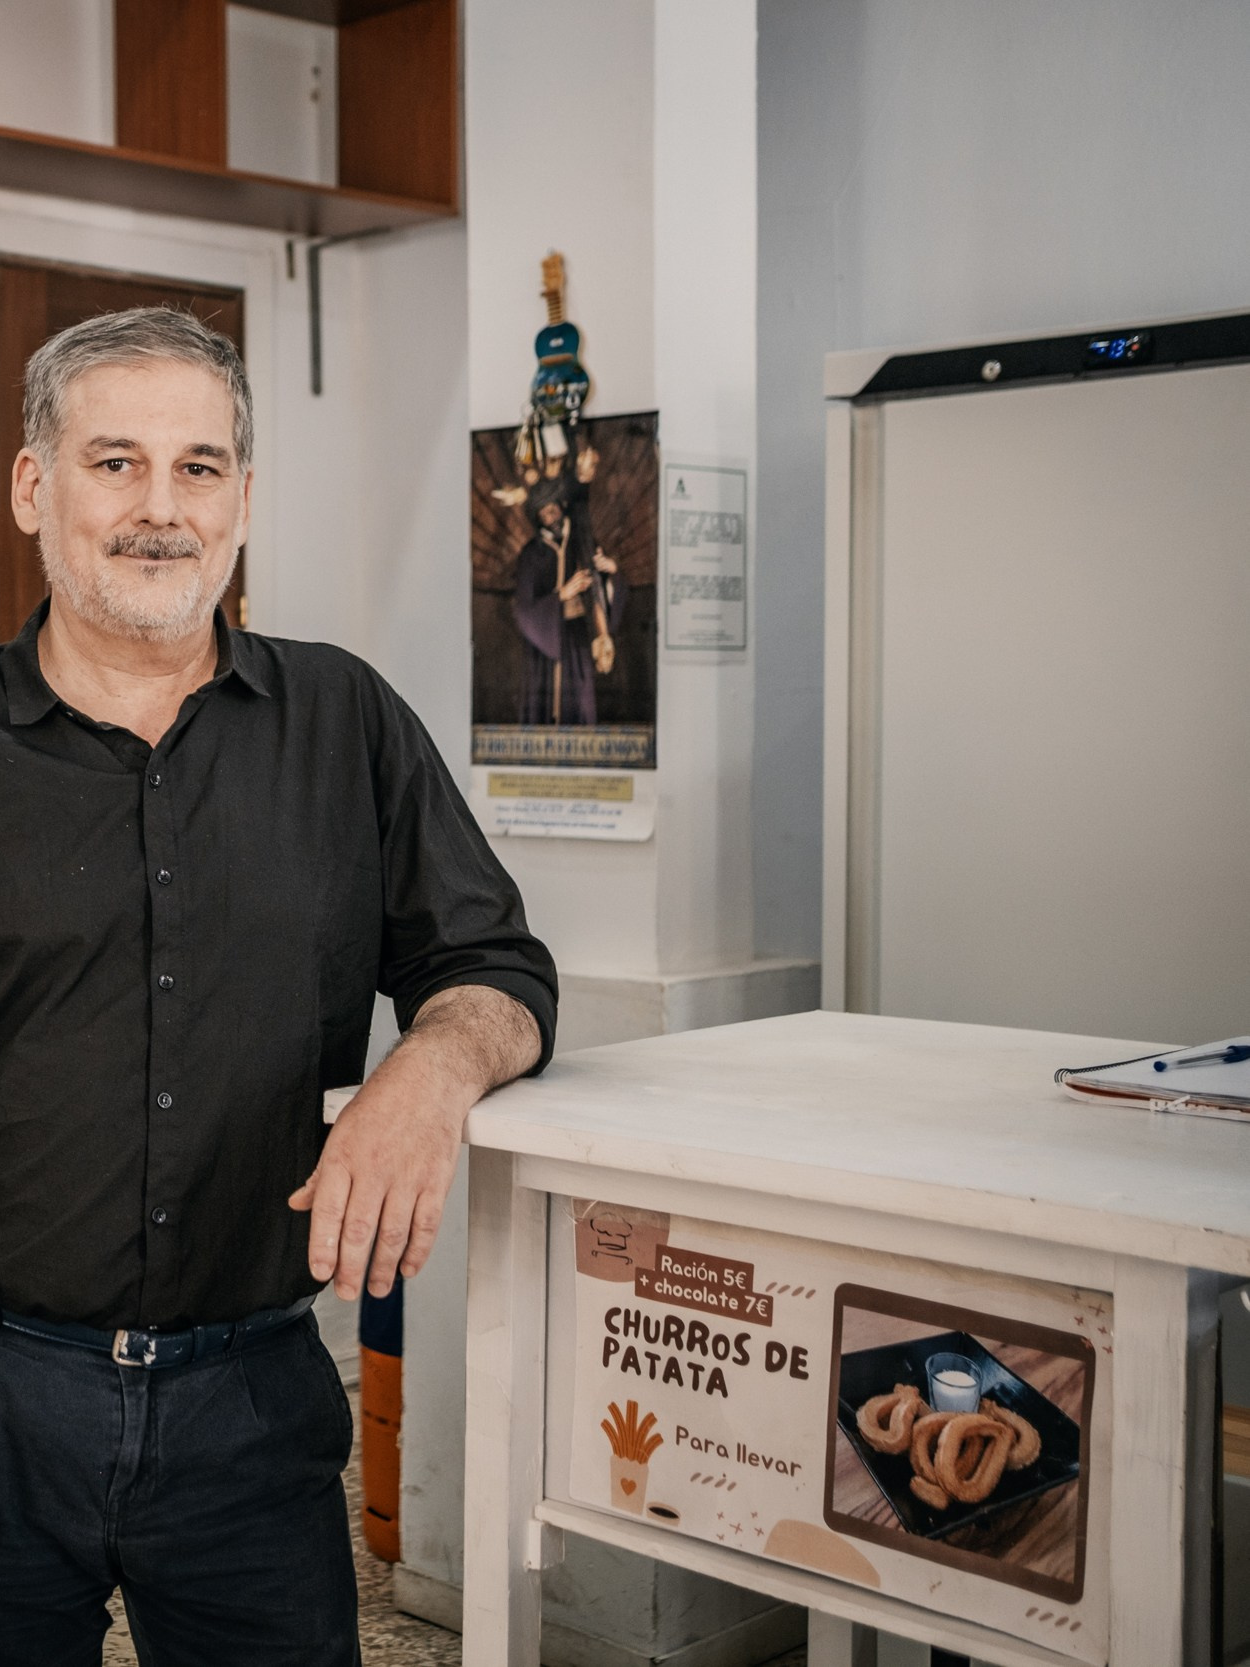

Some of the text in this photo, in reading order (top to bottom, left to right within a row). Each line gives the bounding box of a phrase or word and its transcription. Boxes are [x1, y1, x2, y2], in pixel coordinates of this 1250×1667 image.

[639, 1274, 769, 1318] + chocolate 7€
[660, 1254, 747, 1290] Ración 5€
[602, 1336, 729, 1399] PATATA
[604, 1306, 810, 1381] CHURROS DE
[675, 1424, 802, 1477] Para llevar
